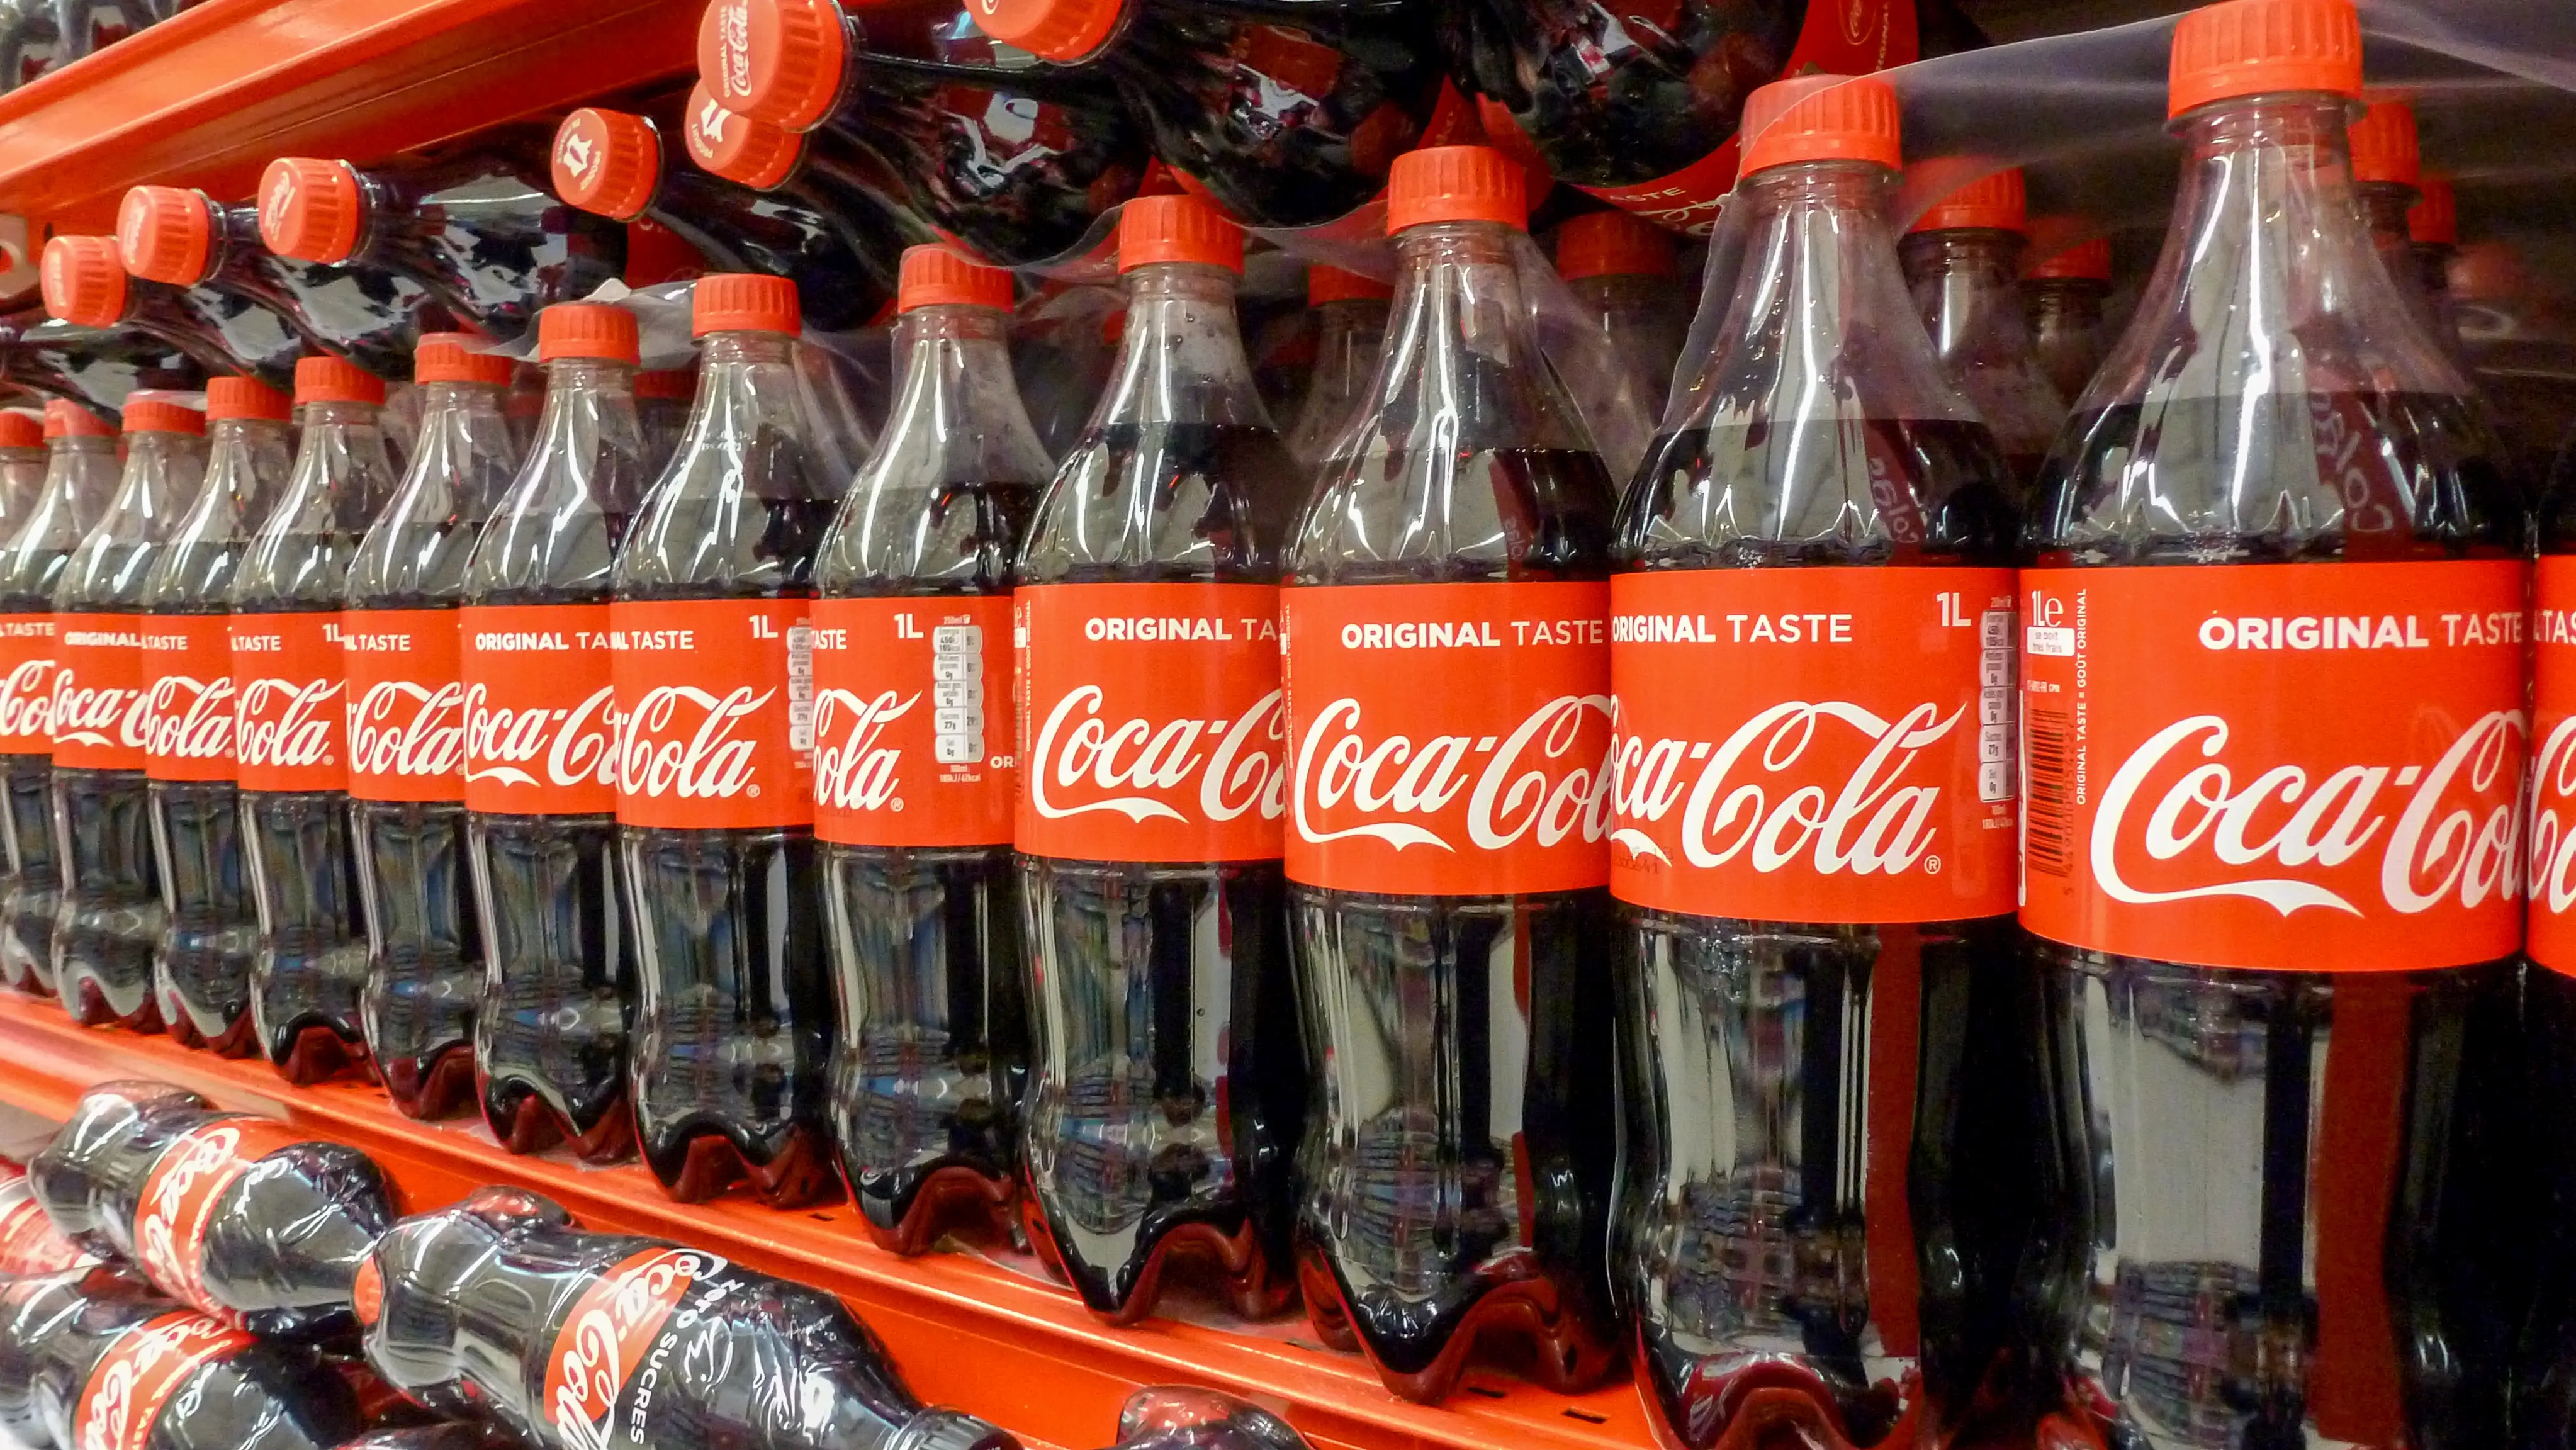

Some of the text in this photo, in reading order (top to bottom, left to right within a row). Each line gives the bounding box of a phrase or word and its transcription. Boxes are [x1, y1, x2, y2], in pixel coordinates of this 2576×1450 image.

[728, 4, 752, 97] Coca-Cola
[1936, 592, 1971, 627] 1L
[2076, 588, 2088, 649] ORIGINAL
[6, 622, 55, 636] TASTE
[631, 630, 694, 650] TASTE
[749, 614, 779, 639] 1L
[893, 613, 924, 639] 1L
[1085, 617, 1232, 641] ORIGINAL
[1341, 619, 1604, 649] ORIGINAL TASTE
[1612, 613, 1852, 643] ORIGINAL TASTE
[2198, 616, 2429, 651] ORIGINAL
[2441, 612, 2523, 647] TASTE
[239, 634, 282, 652] TASTE
[358, 634, 411, 651] TASTE
[475, 632, 569, 651] ORIGINAL
[2074, 653, 2087, 688] GOÛT
[2076, 702, 2087, 741] TASTE
[1294, 694, 1612, 853] Coca-Col
[2076, 745, 2087, 806] ORIGINAL
[630, 1332, 678, 1445] SUCRES
